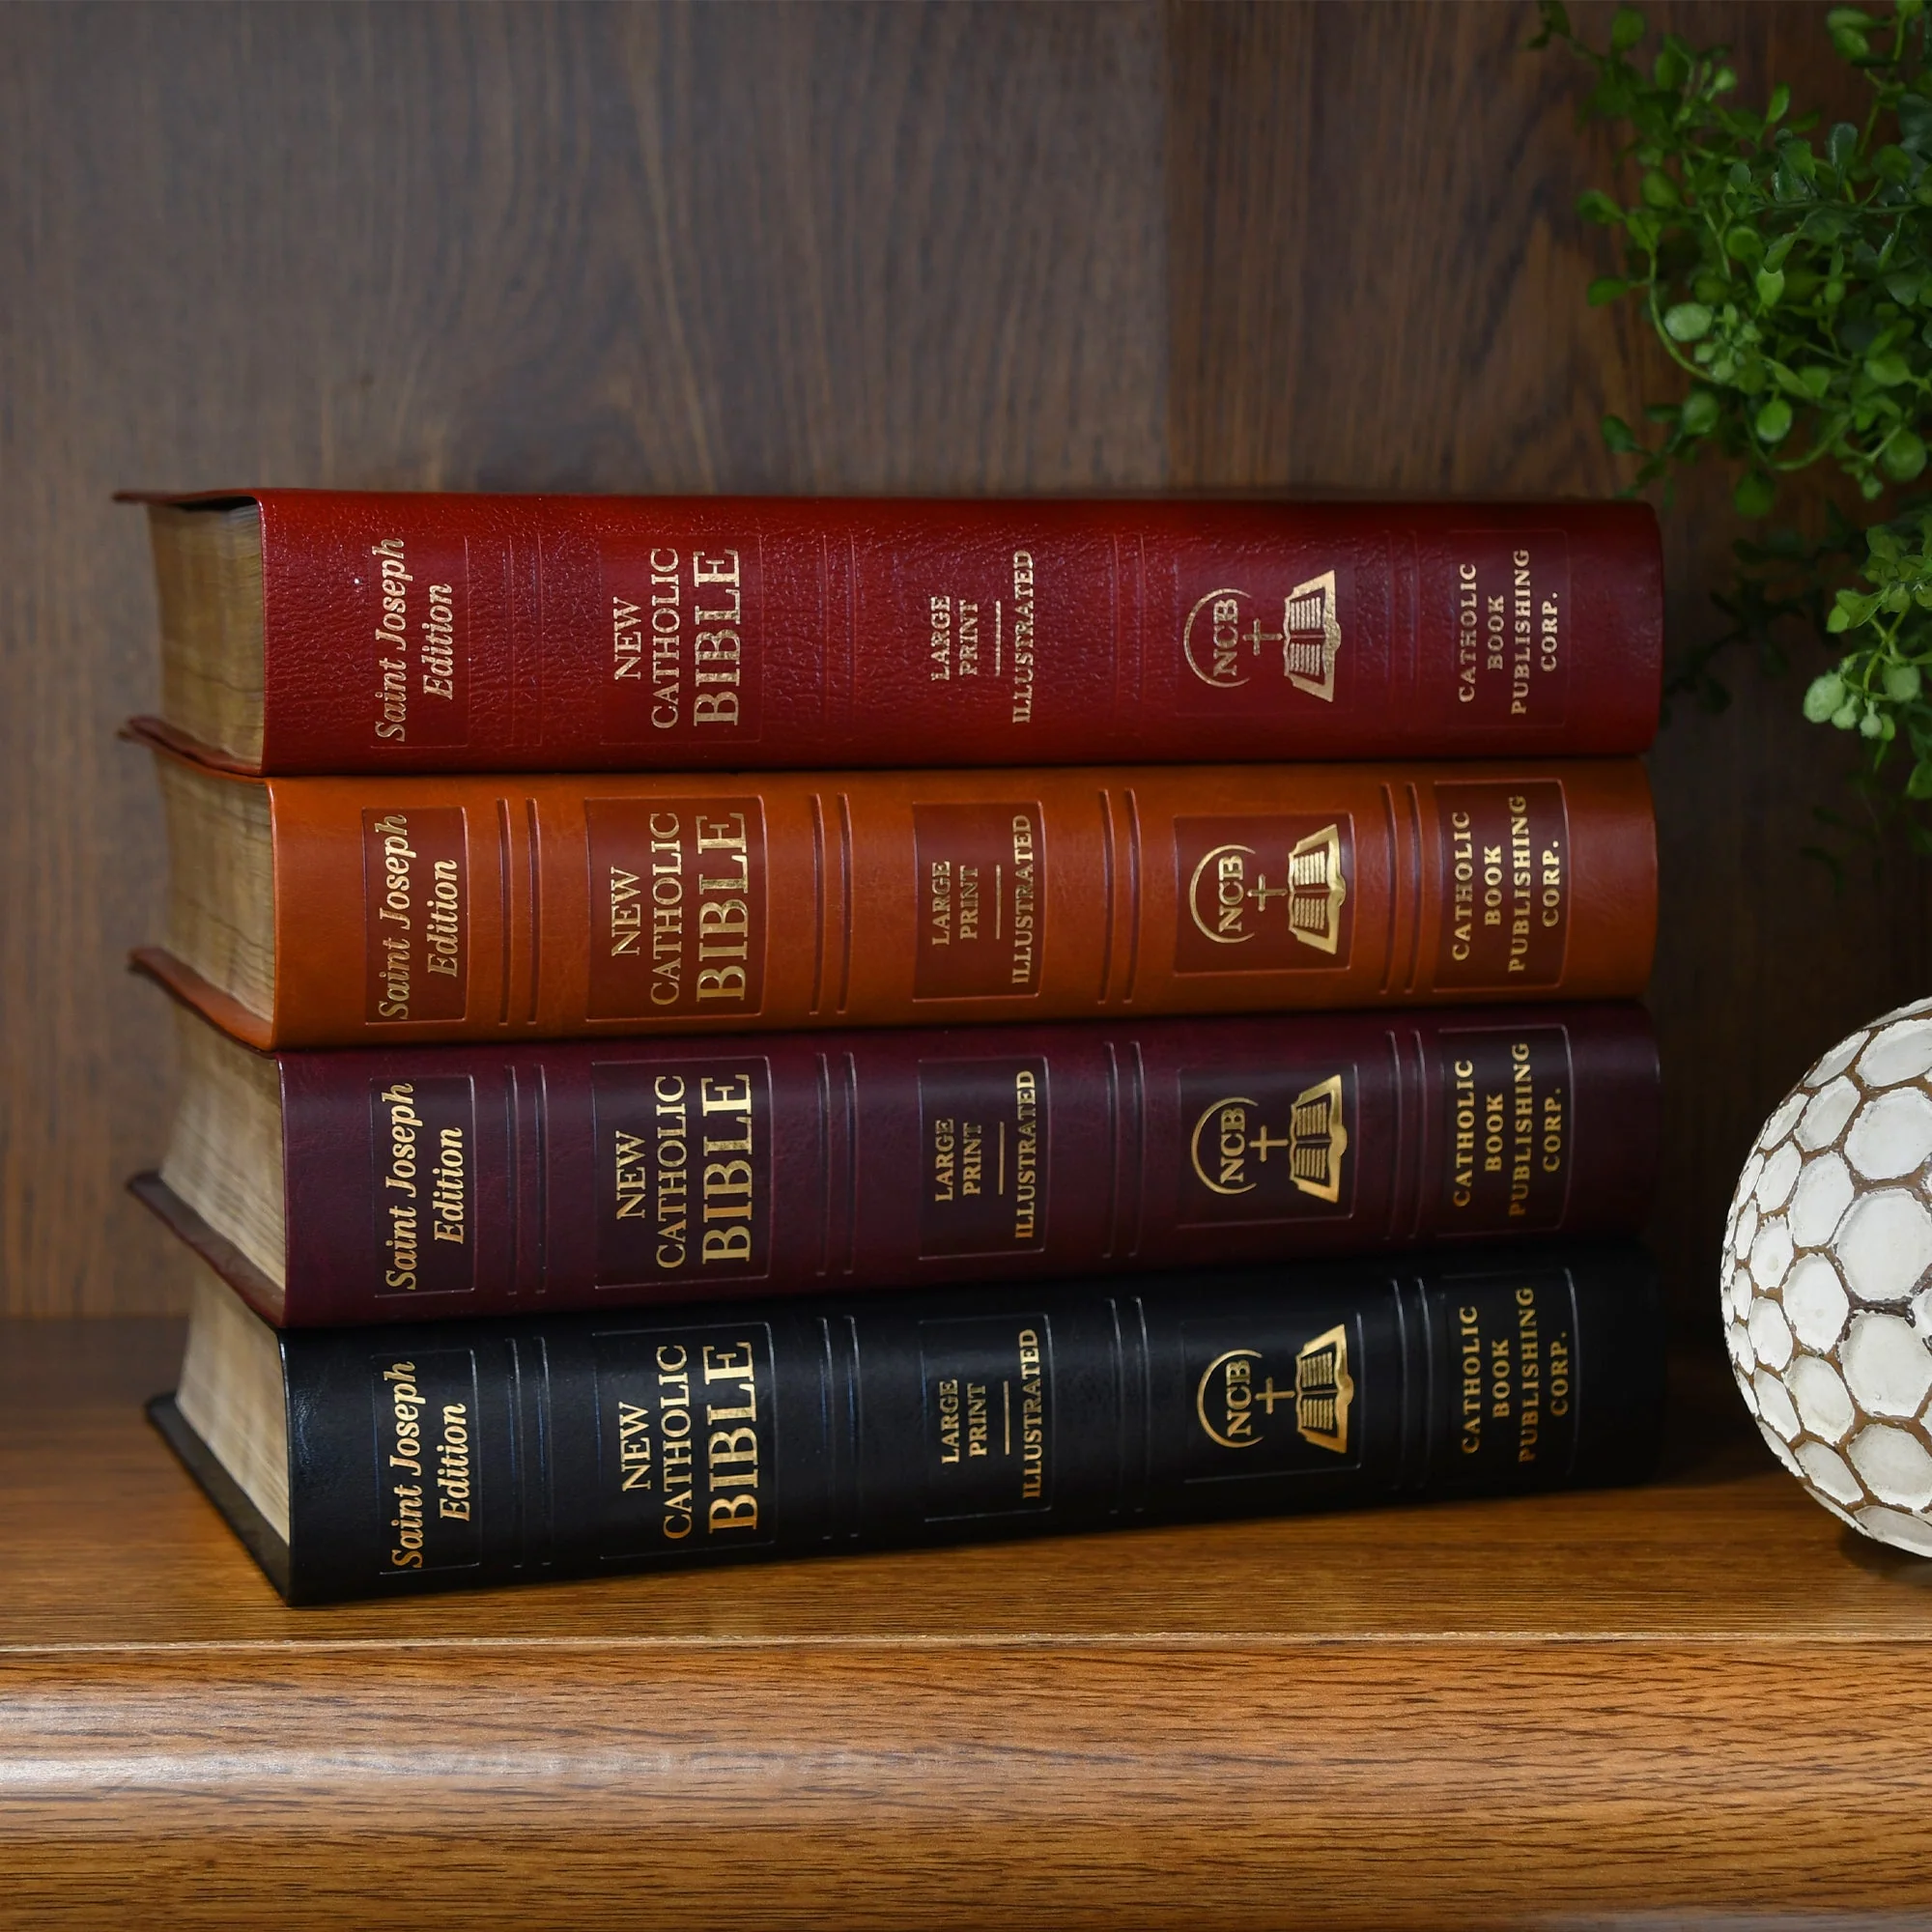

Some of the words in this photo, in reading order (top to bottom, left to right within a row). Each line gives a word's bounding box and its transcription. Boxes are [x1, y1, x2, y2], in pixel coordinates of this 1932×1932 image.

[371, 537, 412, 654] Joseph
[422, 583, 453, 700] Edition
[613, 596, 641, 680] NEW
[650, 548, 680, 728] CATHOLIC
[693, 548, 741, 727] BIBLE
[930, 594, 951, 681] LARGE
[959, 600, 979, 676] PRINT
[1012, 550, 1034, 724] ILLUSTRATED
[1212, 598, 1238, 675] NCB
[1458, 563, 1477, 702] CATHOLIC
[1486, 594, 1504, 669] BOOK
[1511, 548, 1531, 715] PUBLISHING
[1540, 591, 1558, 671] CORP.
[375, 660, 409, 742] Saint
[375, 814, 417, 931] Joseph
[427, 860, 458, 978] Edition
[611, 867, 640, 956] NEW
[650, 811, 683, 1006] CATHOLIC
[696, 811, 749, 1003] BIBLE
[931, 861, 951, 946] LARGE
[959, 866, 979, 940] PRINT
[1011, 814, 1033, 984] ILLUSTRATED
[1218, 854, 1243, 932] NCB
[1452, 811, 1469, 961] CATHOLIC
[1484, 844, 1502, 925] BOOK
[1508, 795, 1527, 973] PUBLISHING
[1541, 840, 1560, 926] CORP.
[379, 939, 411, 1019] Saint
[382, 1082, 425, 1201] Joseph
[615, 1130, 645, 1219] NEW
[653, 1074, 686, 1268] CATHOLIC
[701, 1074, 753, 1264] BIBLE
[935, 1118, 954, 1203] LARGE
[962, 1122, 982, 1197] PRINT
[1015, 1069, 1036, 1239] ILLUSTRATED
[1219, 1105, 1245, 1184] NCB
[1452, 1060, 1473, 1208] CATHOLIC
[1484, 1093, 1503, 1172] BOOK
[1508, 1042, 1531, 1216] PUBLISHING
[1542, 1088, 1561, 1172] CORP.
[434, 1126, 464, 1244] Edition
[385, 1208, 416, 1291] Saint
[384, 1360, 429, 1477] Joseph
[941, 1378, 959, 1465] LARGE
[968, 1382, 987, 1458] PRINT
[1018, 1328, 1041, 1500] ILLUSTRATED
[1225, 1357, 1251, 1436] NCB
[1461, 1306, 1479, 1453] CATHOLIC
[1492, 1338, 1510, 1418] BOOK
[1518, 1287, 1534, 1463] PUBLISHING
[1549, 1332, 1568, 1417] CORP.
[440, 1403, 470, 1522] Edition
[619, 1402, 651, 1492] NEW
[656, 1345, 692, 1539] CATHOLIC
[703, 1341, 758, 1533] BIBLE
[390, 1486, 423, 1569] Saint
